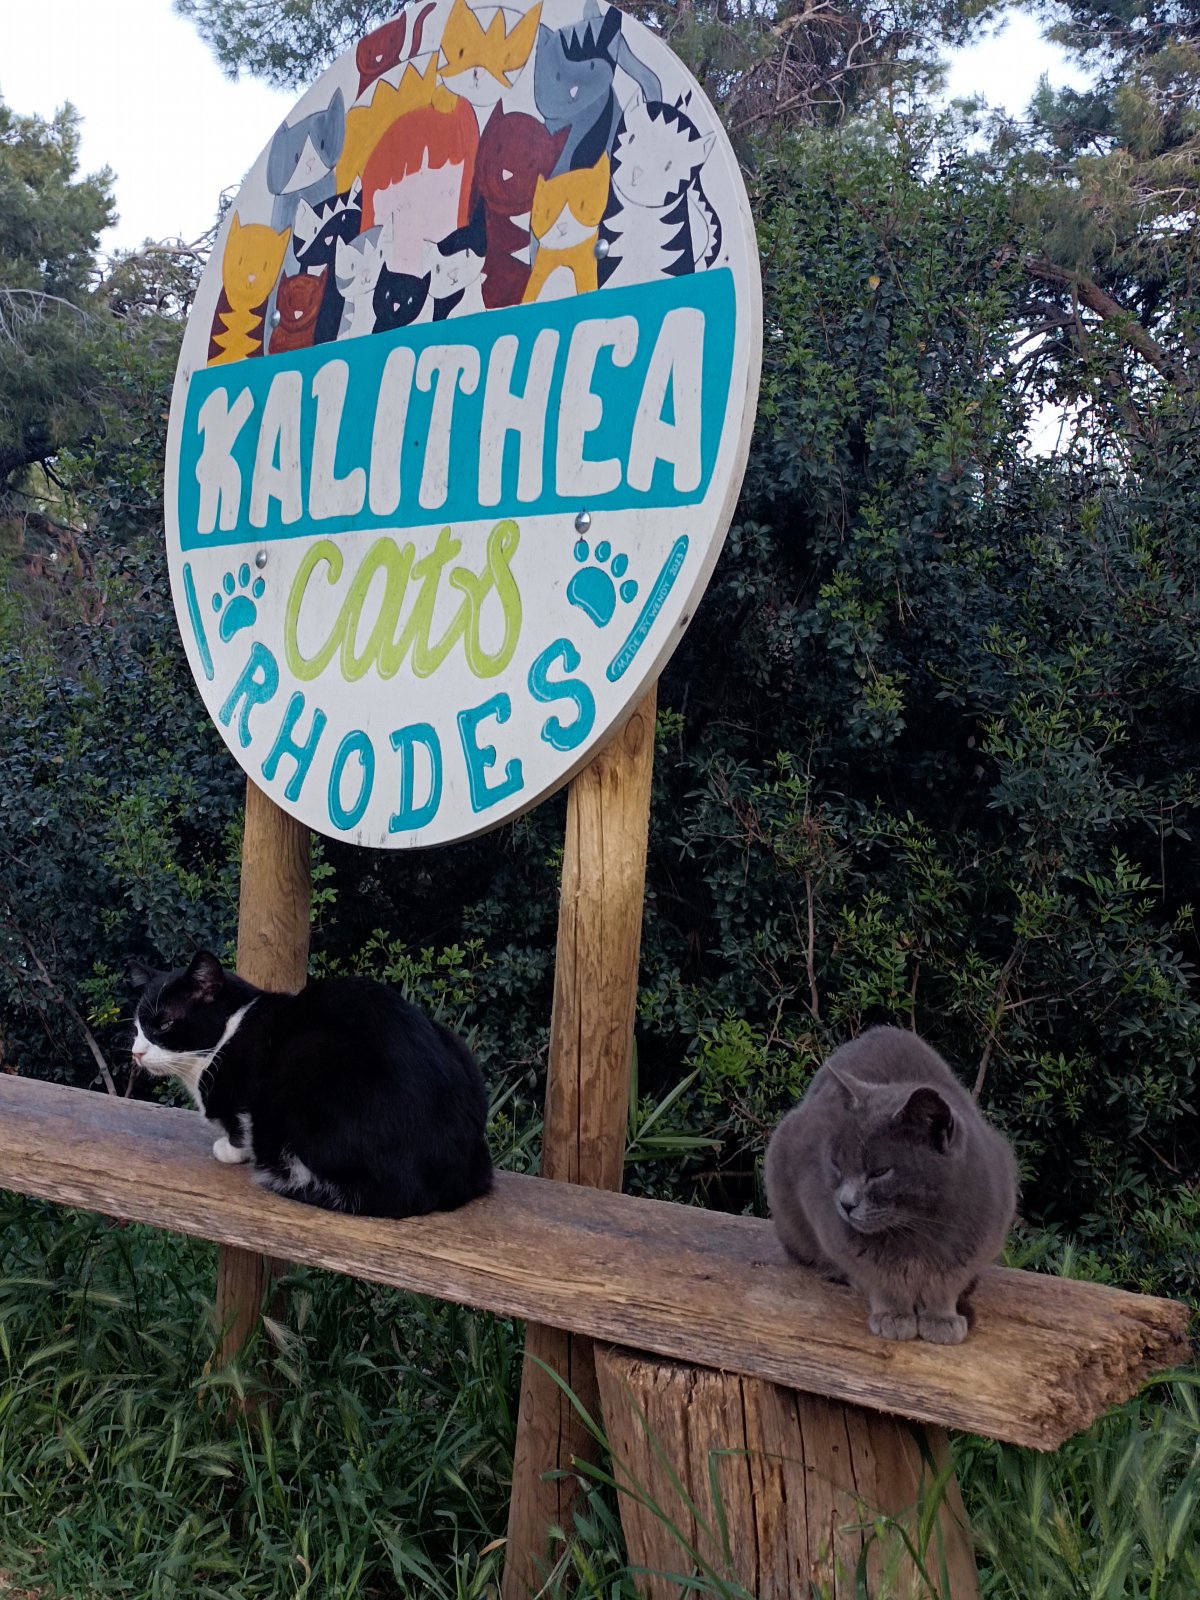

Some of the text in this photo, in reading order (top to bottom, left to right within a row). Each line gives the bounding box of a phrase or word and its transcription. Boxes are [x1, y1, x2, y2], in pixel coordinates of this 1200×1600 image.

[195, 307, 705, 534] KALITHEA
[616, 552, 684, 673] MADE BY WENDY 2023
[218, 638, 596, 834] RHODES
